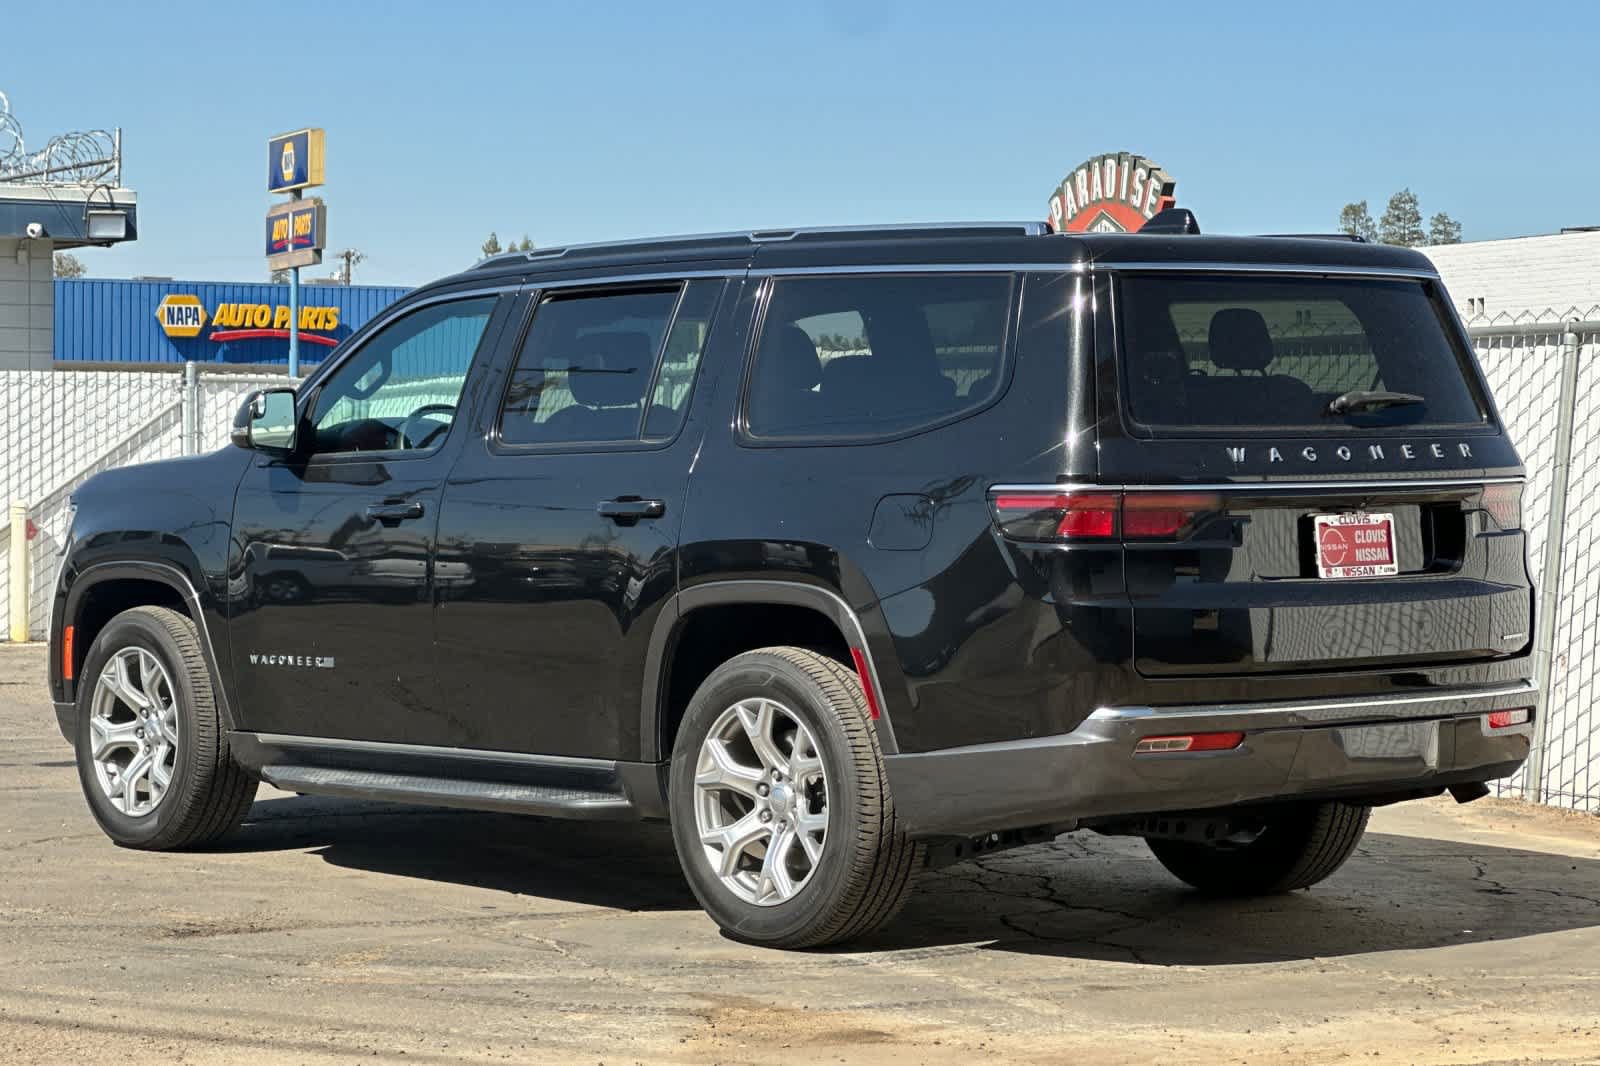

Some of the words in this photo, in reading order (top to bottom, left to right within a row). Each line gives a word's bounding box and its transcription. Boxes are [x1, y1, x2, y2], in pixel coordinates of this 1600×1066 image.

[1050, 158, 1161, 232] PARADISE
[272, 218, 288, 240] AUTO
[166, 306, 200, 326] NAPA
[212, 303, 272, 328] AUTO
[1226, 443, 1473, 463] WAGONEER
[1338, 514, 1371, 524] CLOVIS
[1354, 530, 1387, 543] CLOVIS
[1355, 548, 1389, 561] NISSAN
[1342, 566, 1376, 576] NISSAN
[249, 654, 322, 667] WAGONEER
